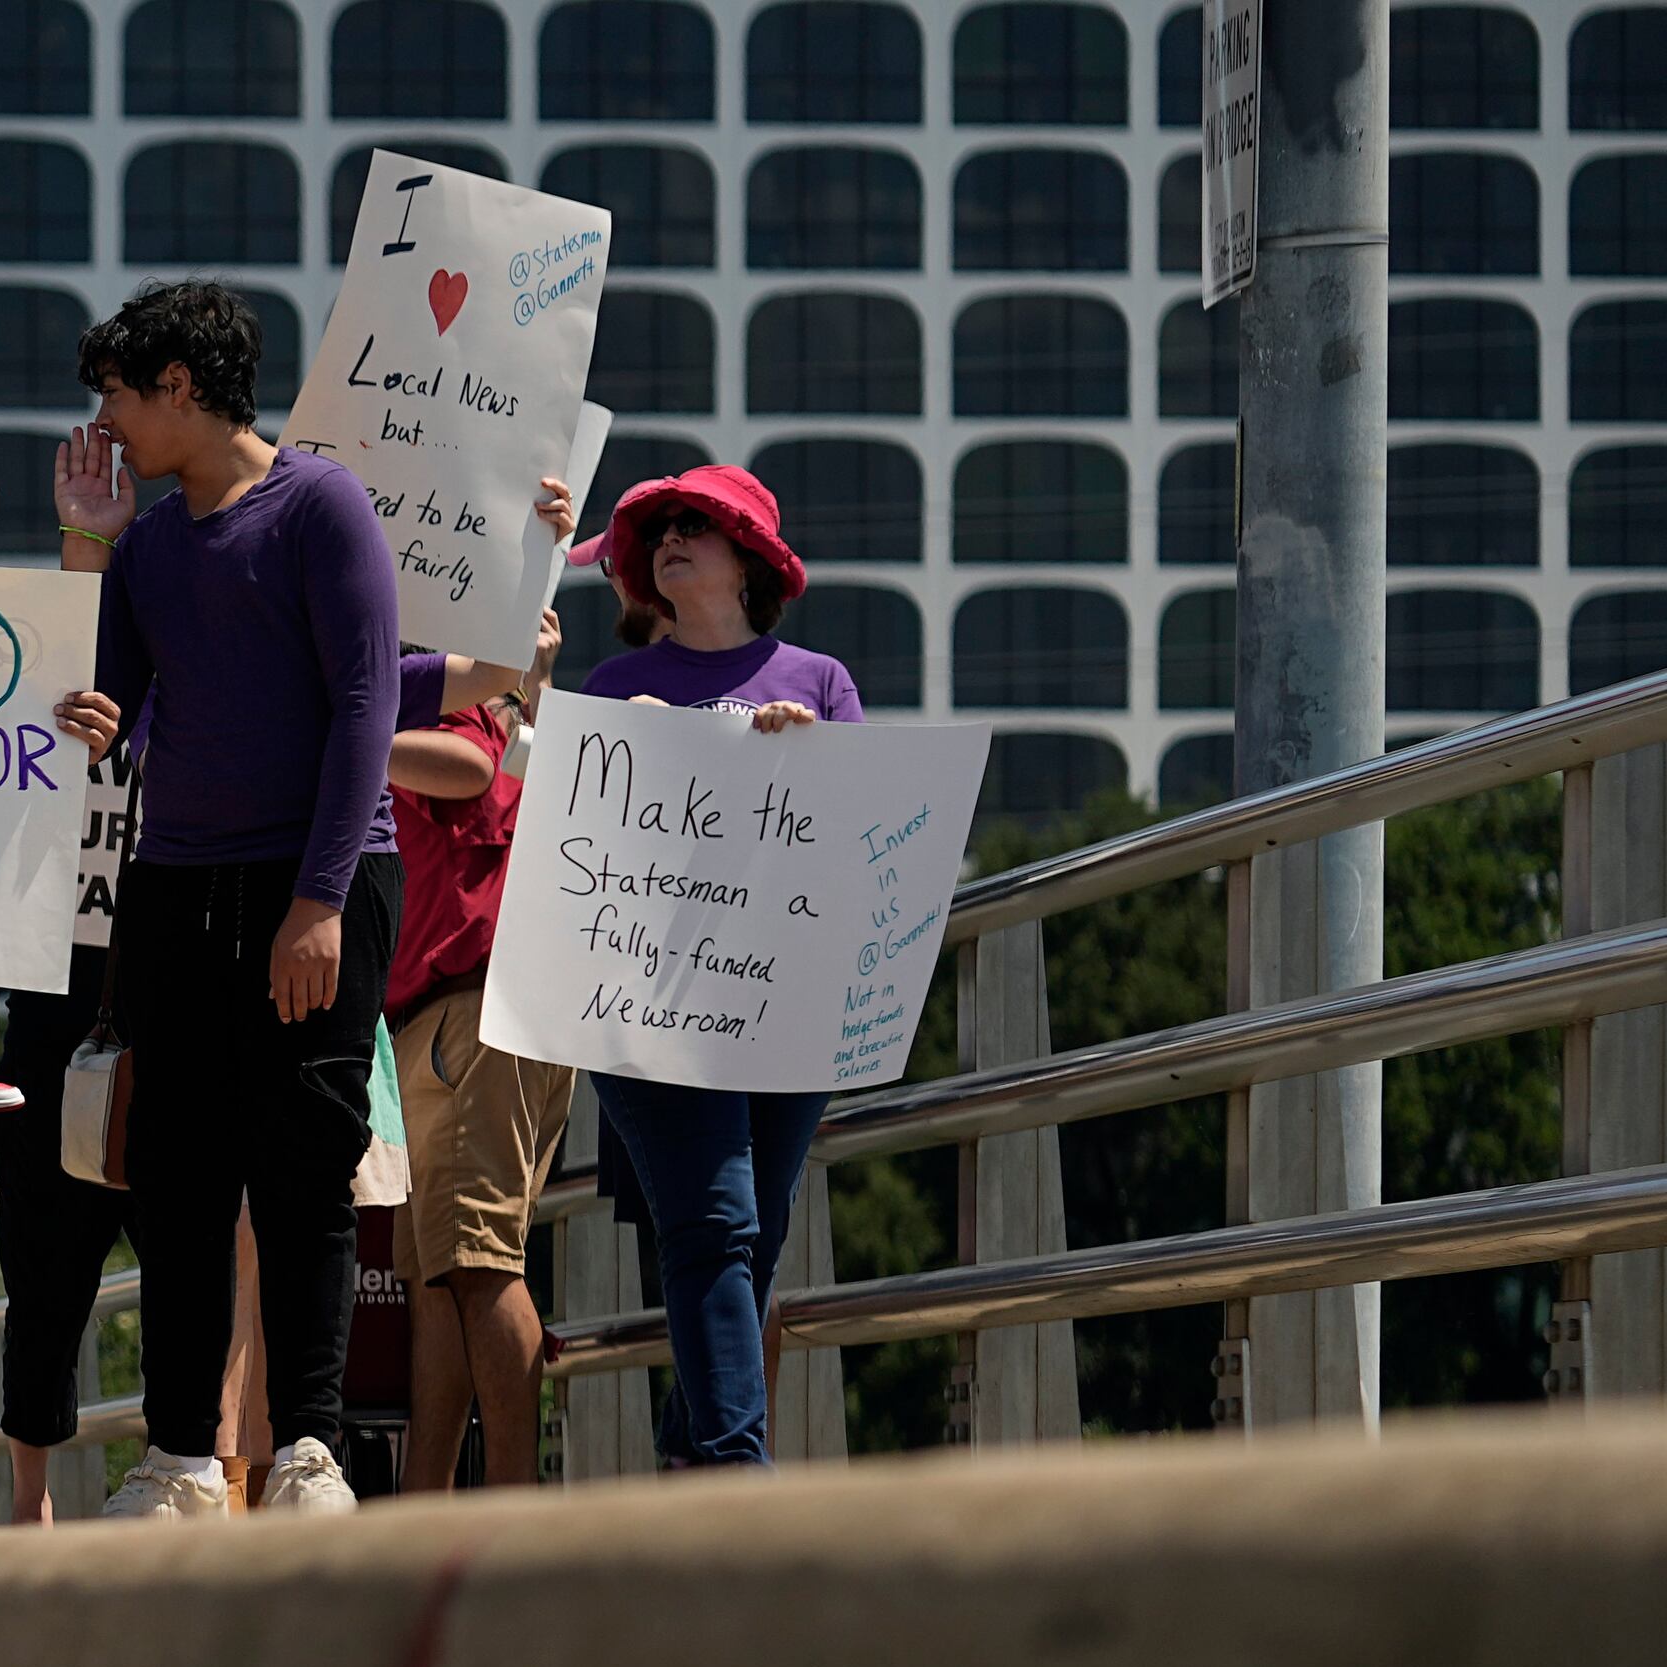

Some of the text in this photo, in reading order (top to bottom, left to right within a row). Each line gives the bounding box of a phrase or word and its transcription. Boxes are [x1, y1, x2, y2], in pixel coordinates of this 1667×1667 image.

[1210, 8, 1250, 87] PARKING
[1205, 91, 1254, 174] ON BRIDGE
[382, 174, 434, 257] I
[509, 230, 603, 287] @Statesman
[514, 256, 595, 326] @Gannett
[348, 334, 520, 418] Local News
[417, 489, 442, 524] to
[453, 501, 487, 536] be
[568, 732, 817, 847] Make the
[859, 803, 932, 865] Invest
[560, 837, 819, 918] Statesman a
[875, 865, 899, 893] in
[871, 896, 901, 929] us
[581, 983, 769, 1043] Newsroom!
[845, 984, 895, 1014] Not in
